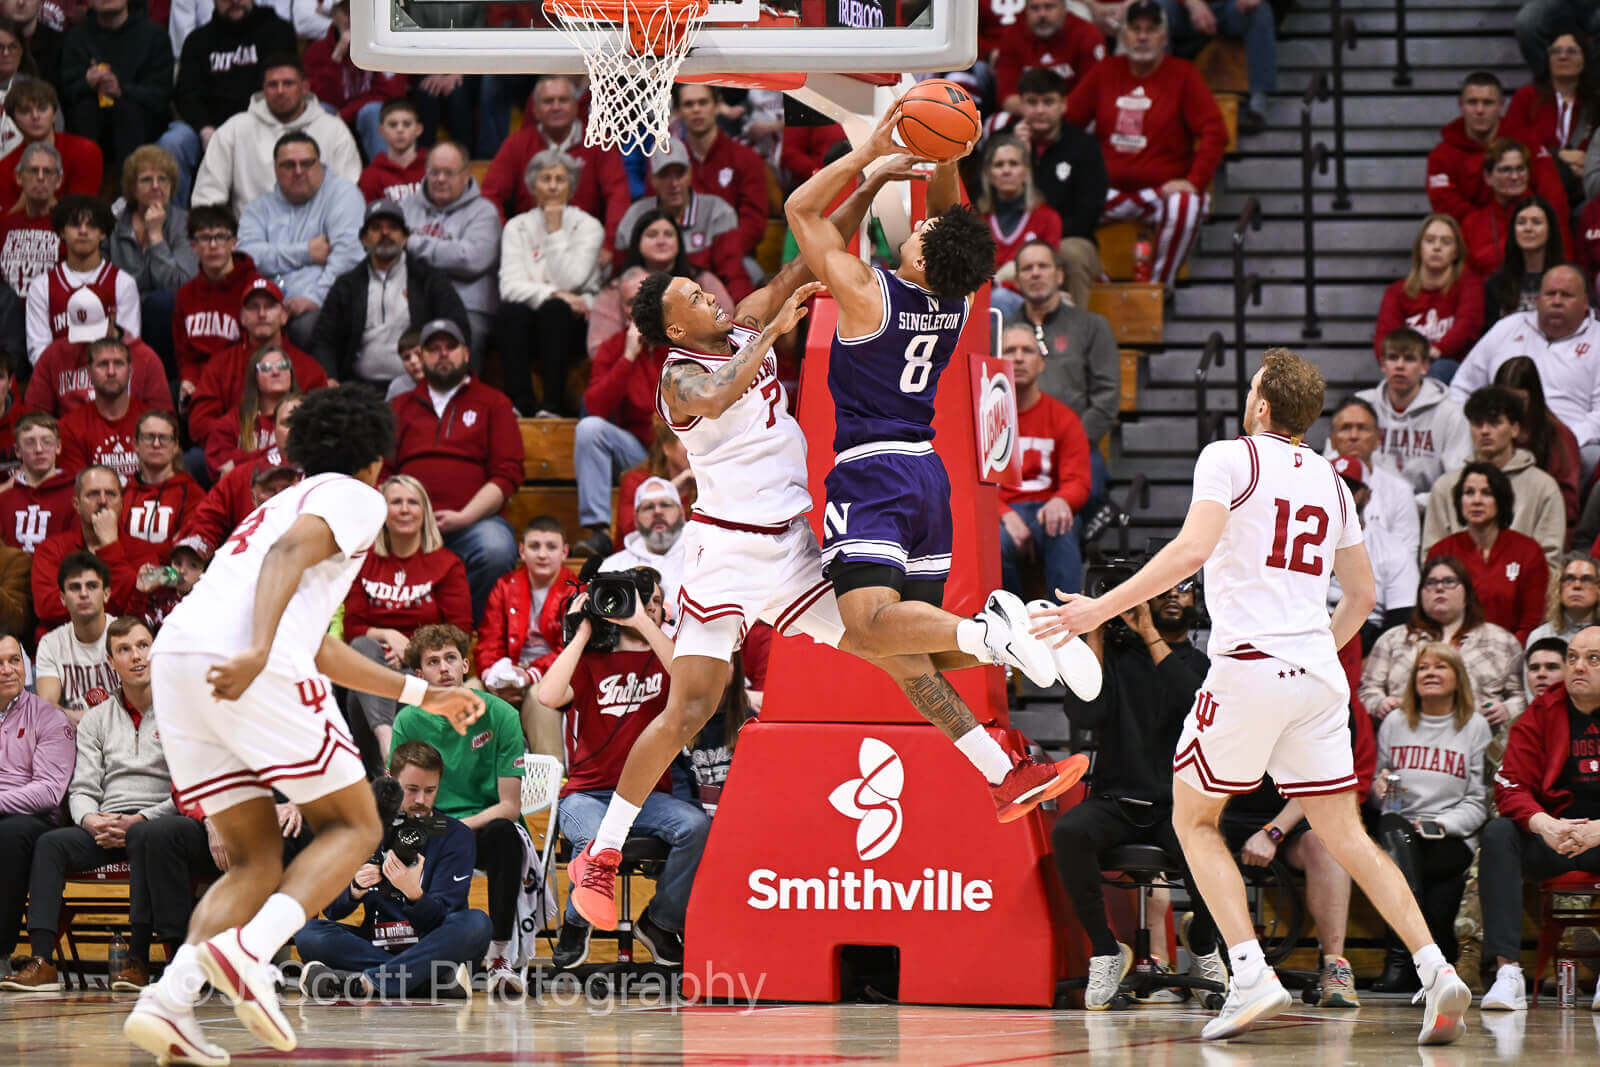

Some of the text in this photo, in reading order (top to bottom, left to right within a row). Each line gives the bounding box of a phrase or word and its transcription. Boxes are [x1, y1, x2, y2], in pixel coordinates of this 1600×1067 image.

[898, 311, 961, 331] SINGLETON
[899, 335, 939, 393] 8
[760, 378, 782, 429] 7
[823, 501, 853, 540] N
[1264, 497, 1330, 577] 12
[596, 672, 663, 706] Indiana
[1390, 745, 1467, 780] INDIANA
[747, 866, 993, 911] Smithville
